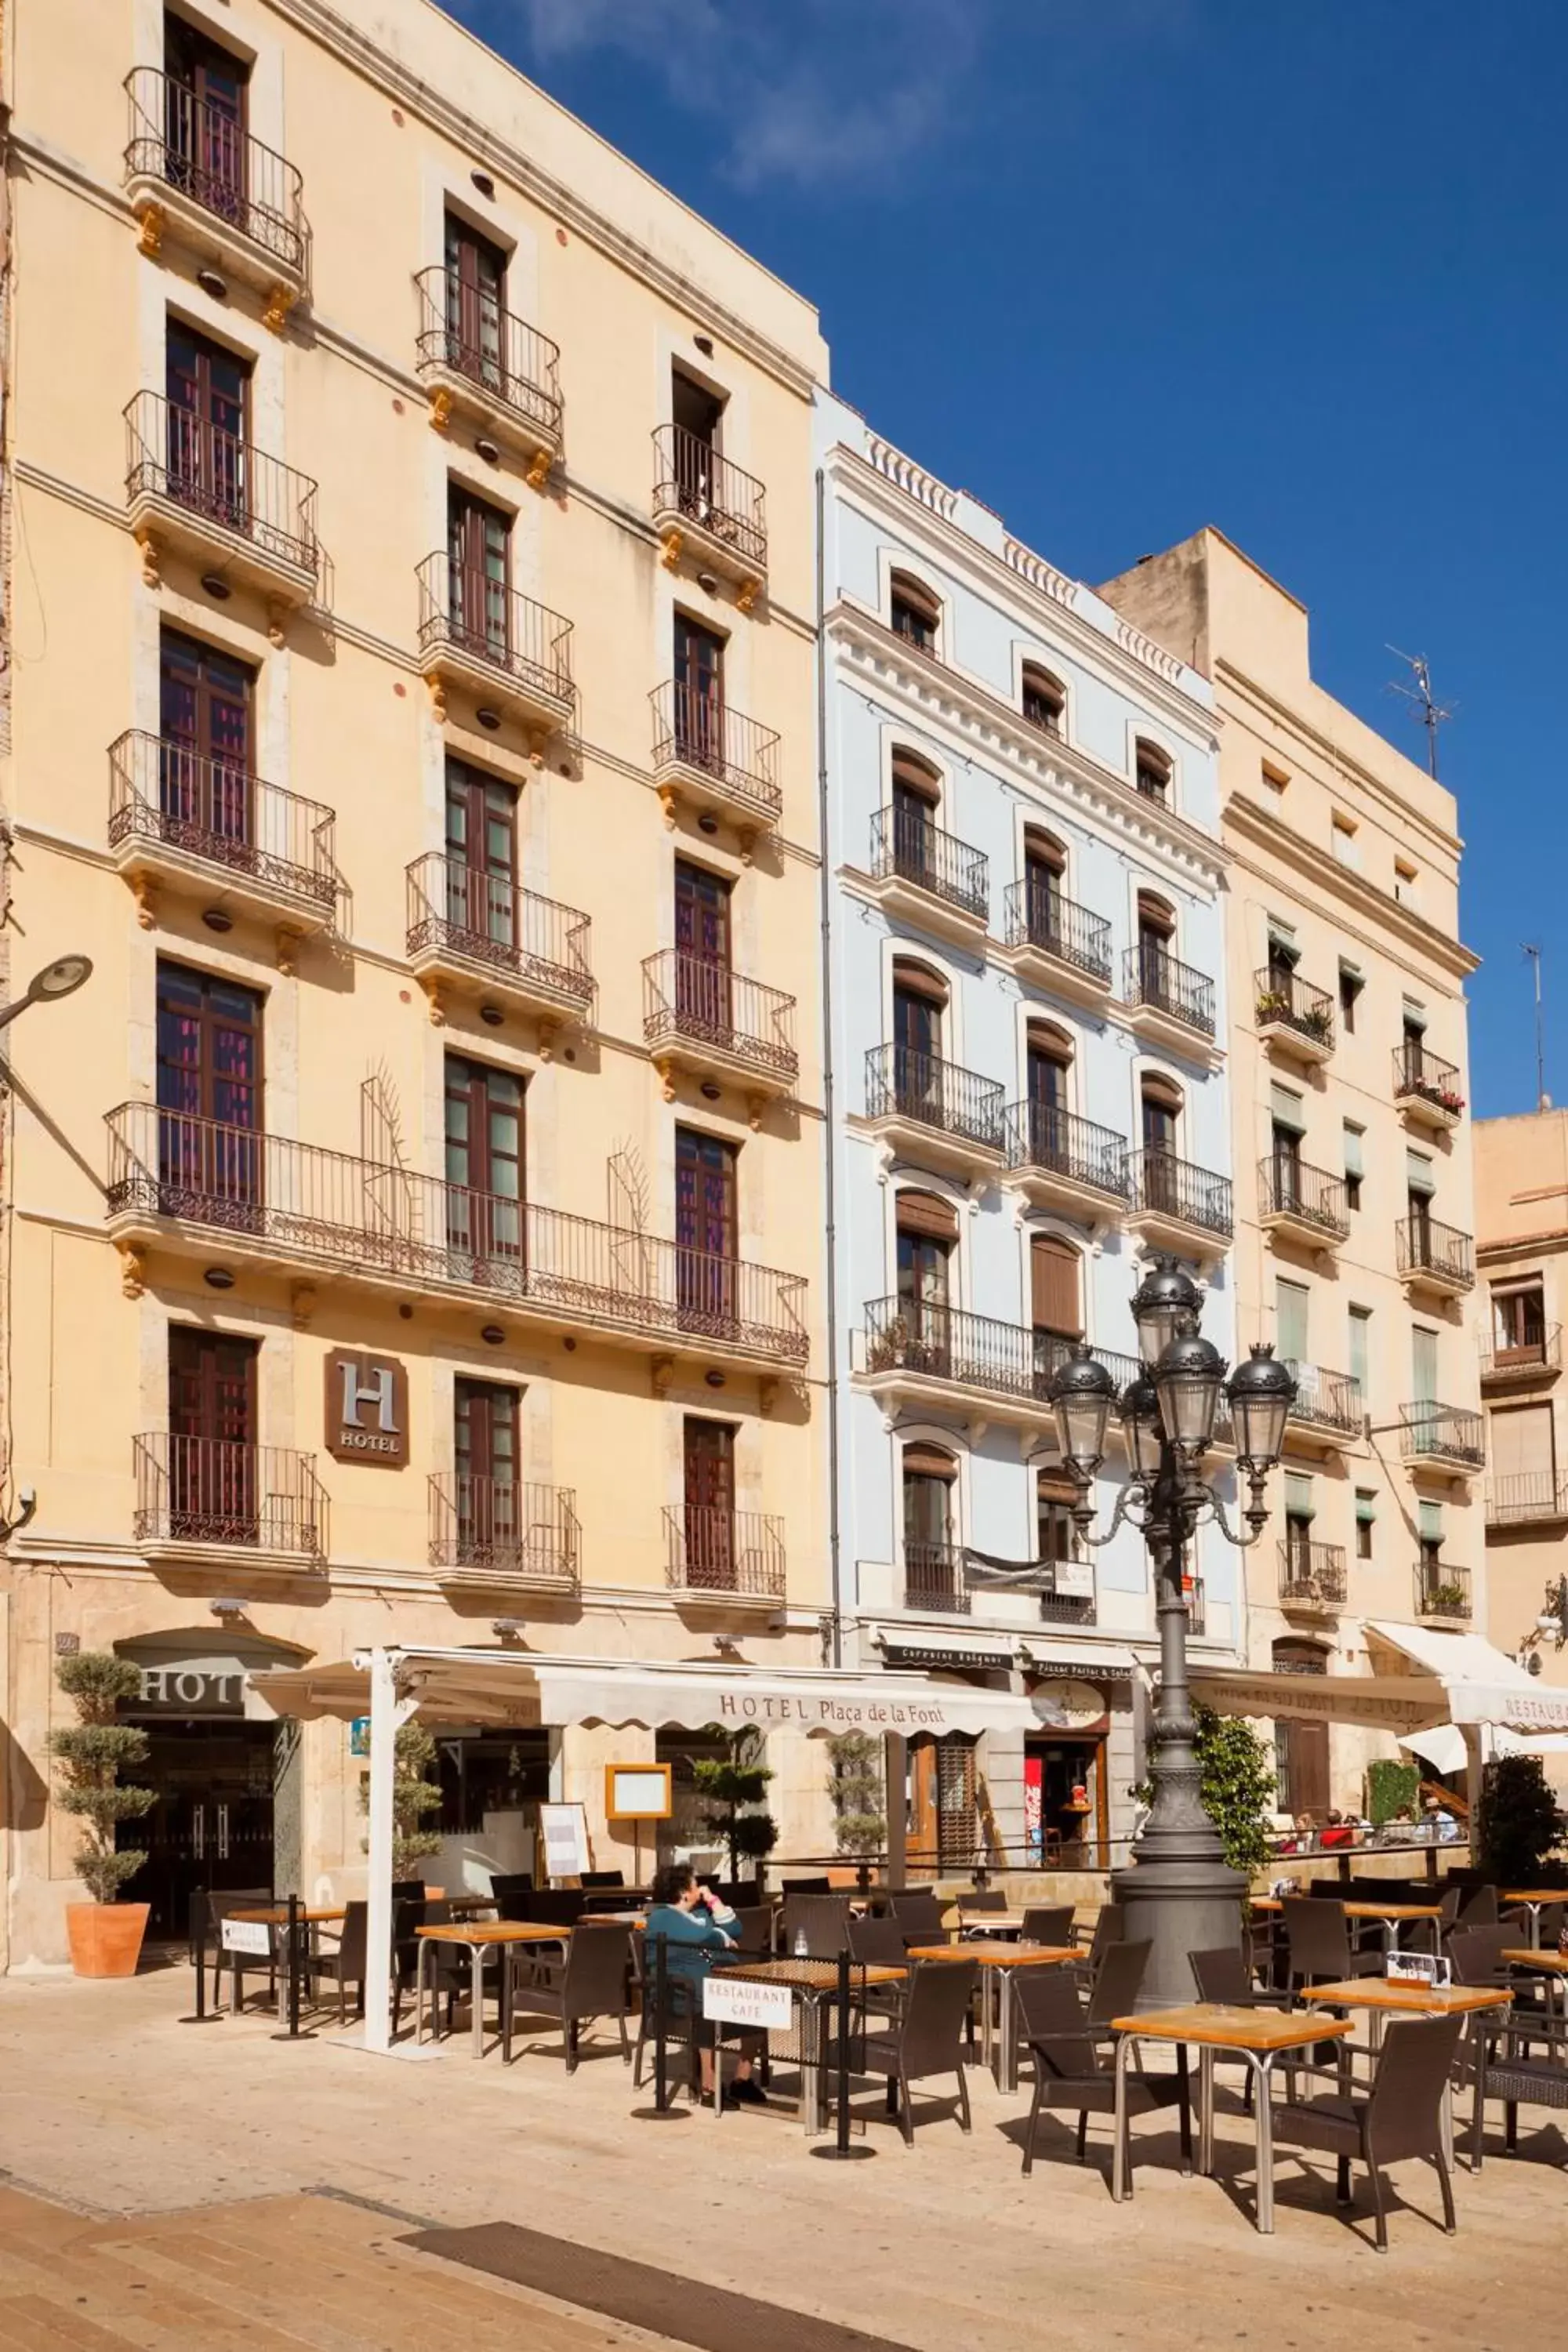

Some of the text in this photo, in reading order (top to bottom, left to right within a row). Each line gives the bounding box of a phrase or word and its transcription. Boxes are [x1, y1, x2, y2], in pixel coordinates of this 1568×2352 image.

[337, 1361, 401, 1434] H
[340, 1432, 399, 1454] HOTEL
[720, 1694, 946, 1726] HOTEL Plaça de la Font
[709, 1983, 786, 2004] RESTAURANT
